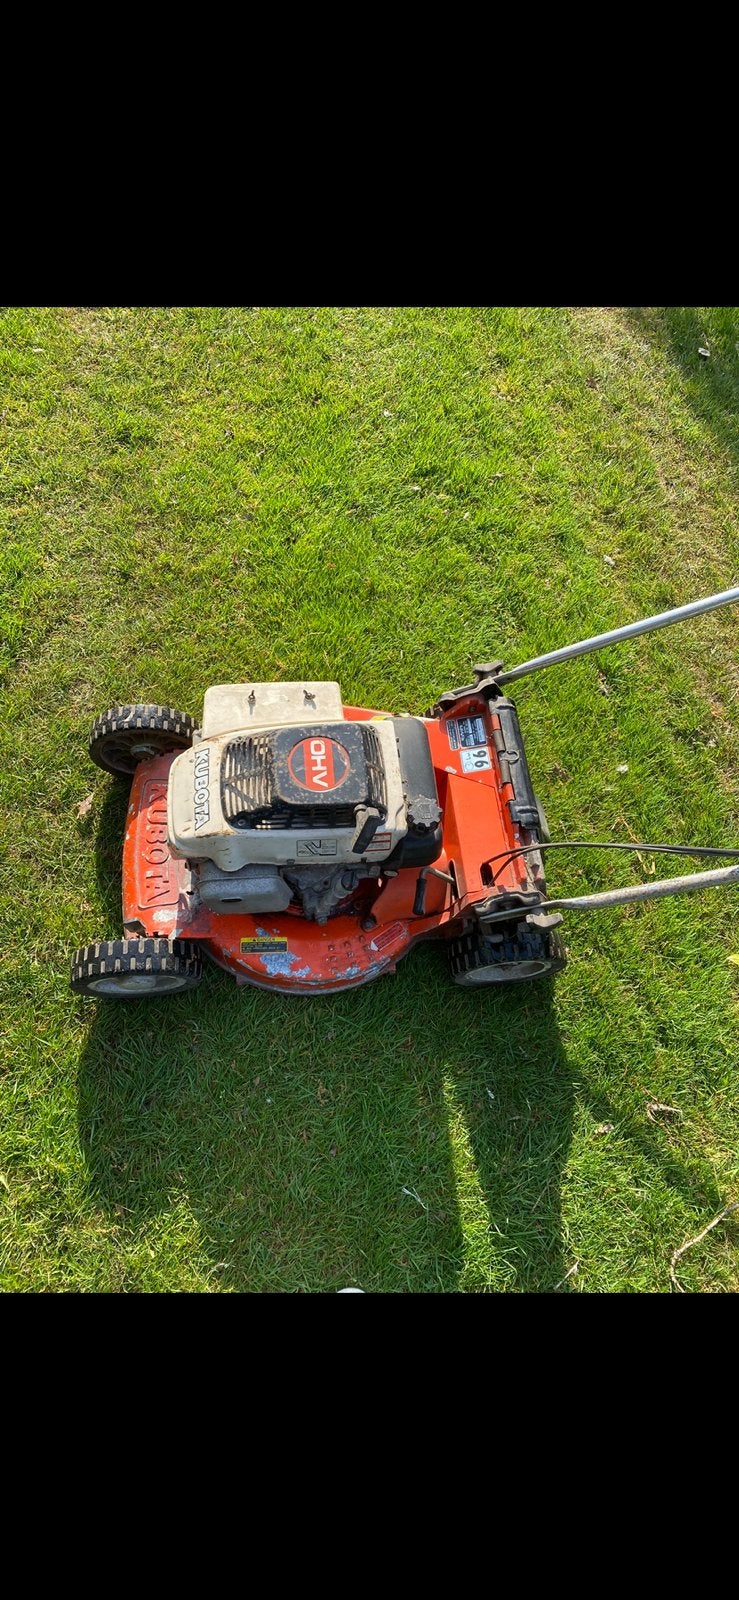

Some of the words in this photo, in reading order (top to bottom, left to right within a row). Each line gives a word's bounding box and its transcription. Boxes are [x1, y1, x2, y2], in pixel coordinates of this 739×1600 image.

[193, 748, 210, 831] KUBOTA
[310, 740, 329, 788] OHV
[473, 750, 488, 768] 96
[145, 786, 170, 903] KUBOTA
